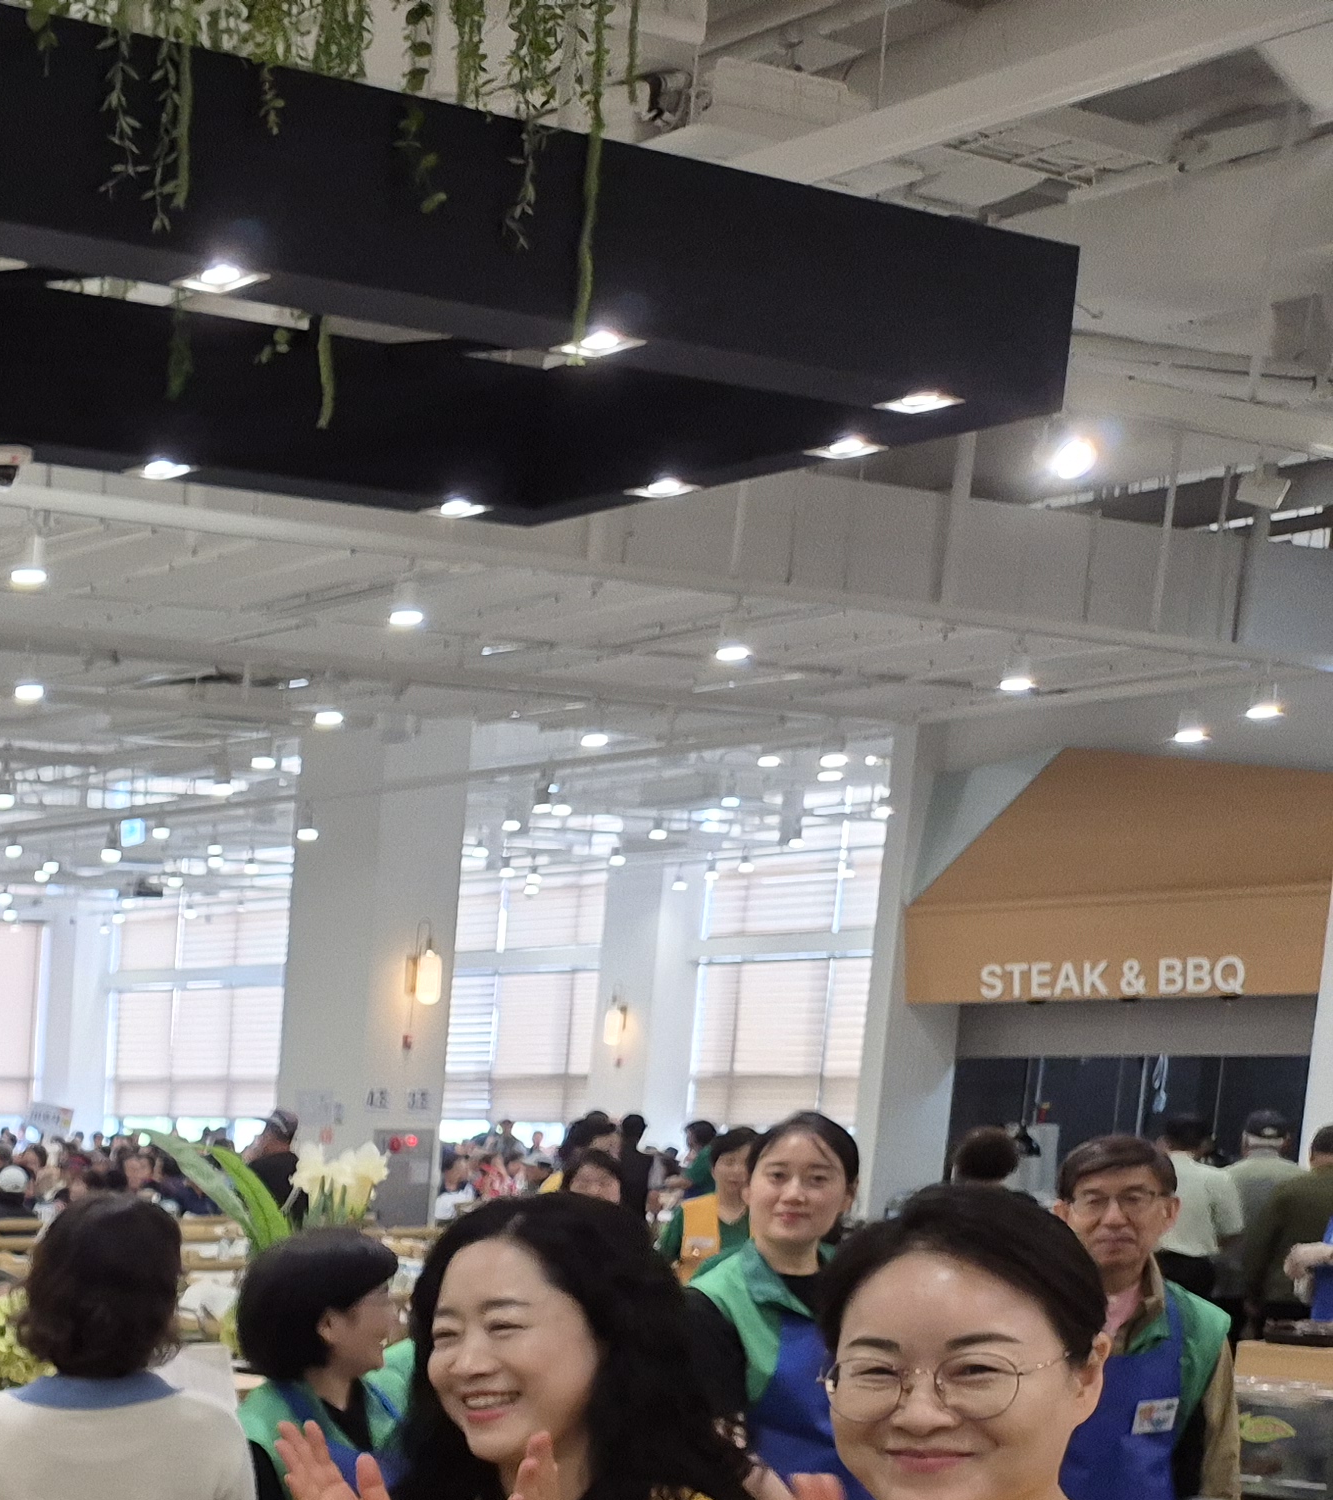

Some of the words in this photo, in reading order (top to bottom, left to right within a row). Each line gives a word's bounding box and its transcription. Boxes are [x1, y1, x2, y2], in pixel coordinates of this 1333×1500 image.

[979, 959, 1109, 999] STEAK
[1120, 957, 1148, 996] &
[1158, 954, 1246, 995] BBQ
